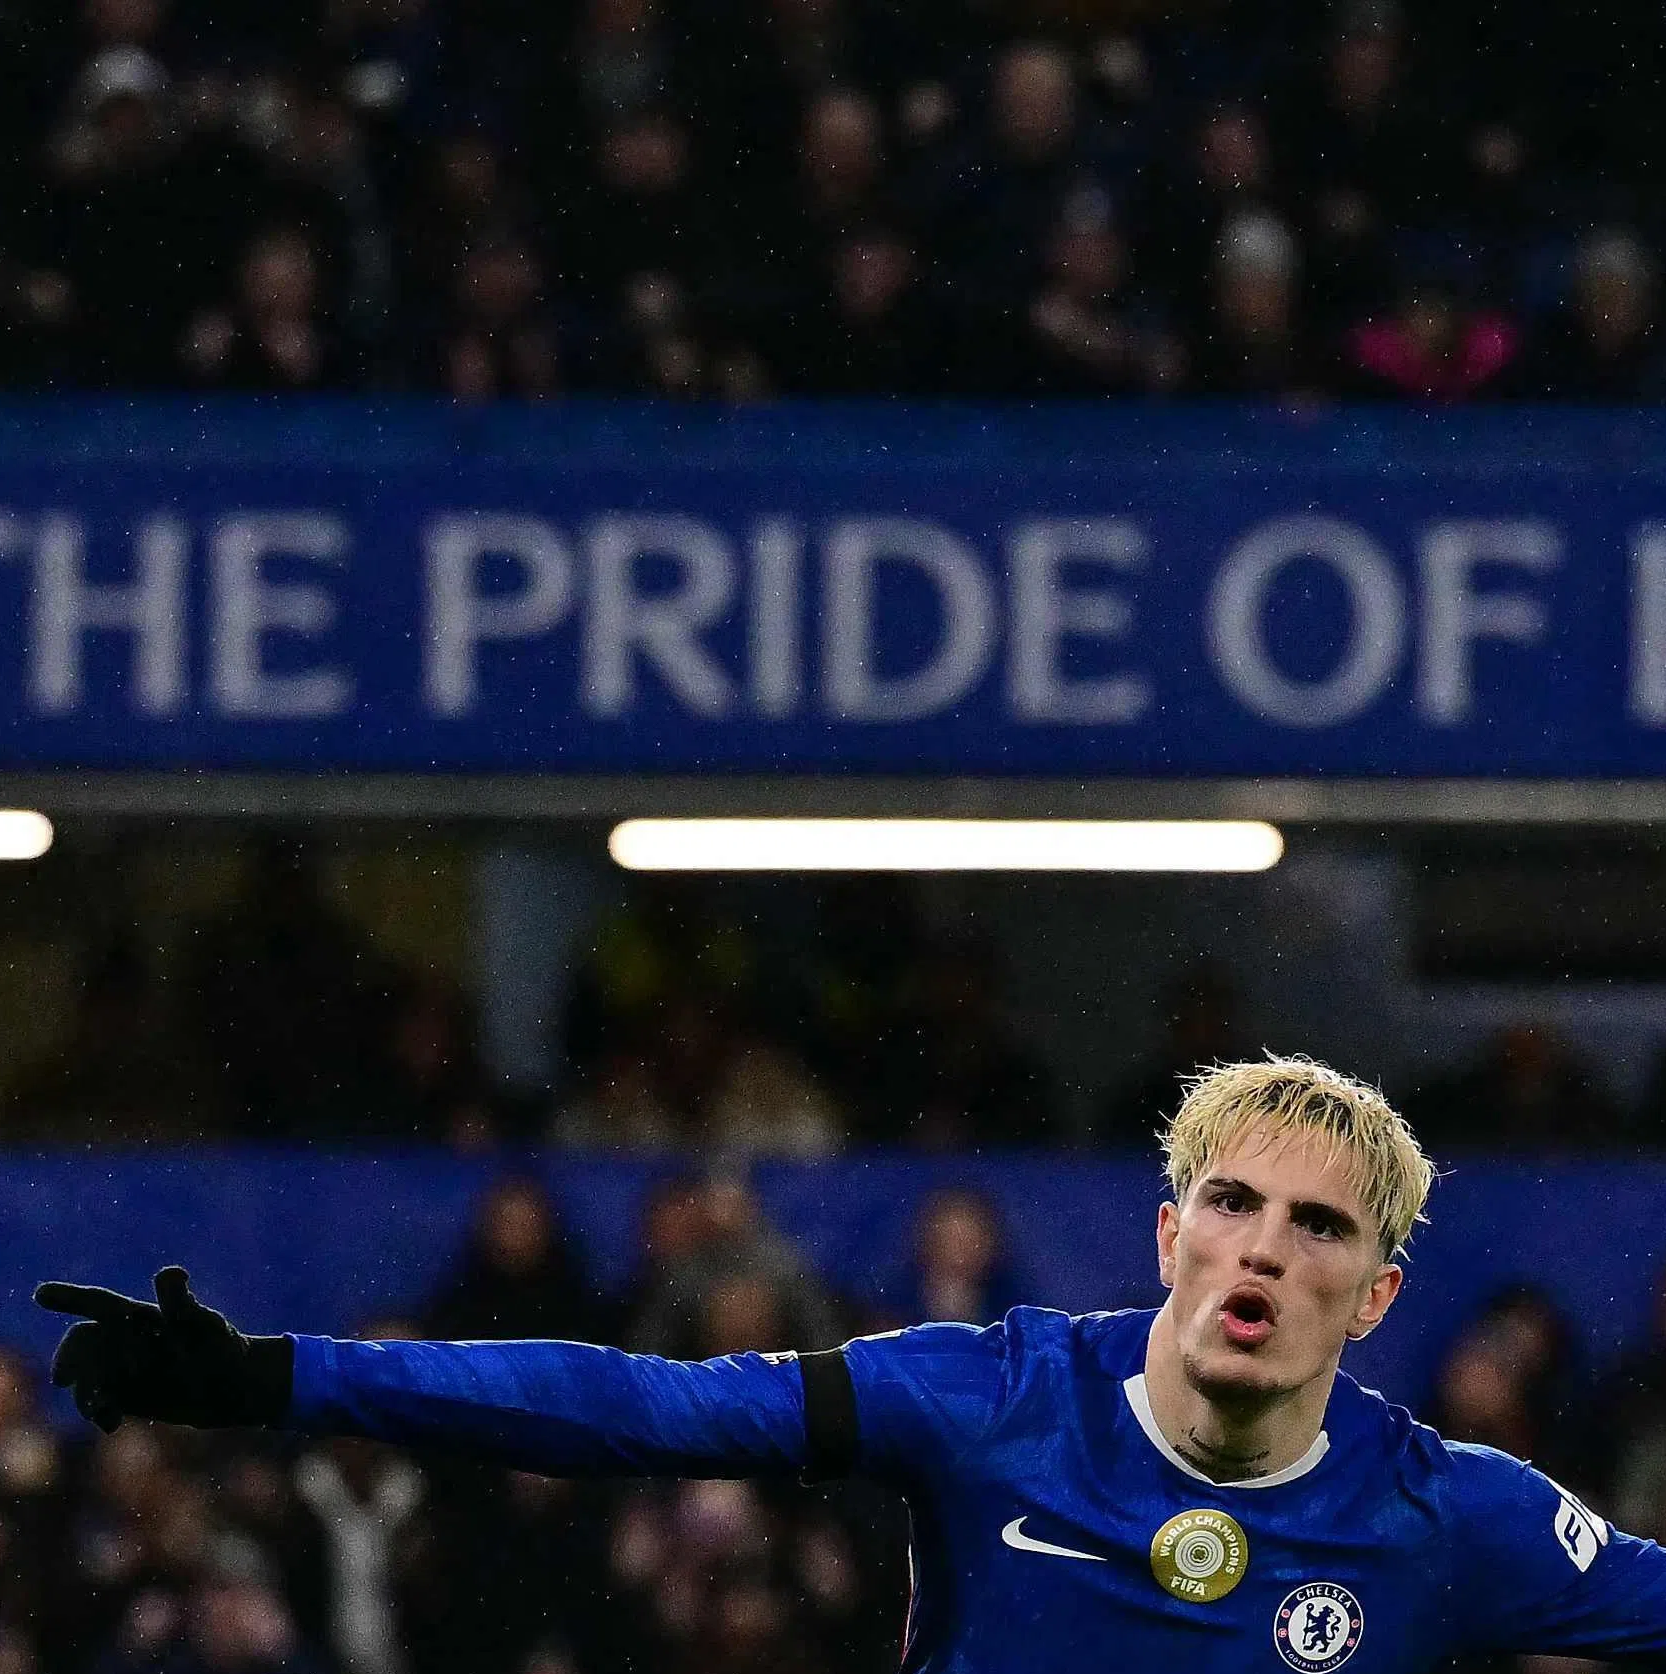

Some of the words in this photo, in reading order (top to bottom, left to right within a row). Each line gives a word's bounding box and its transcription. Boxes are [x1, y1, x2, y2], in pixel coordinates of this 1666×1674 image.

[423, 512, 1149, 721] PRIDE
[1205, 516, 1561, 726] OF
[1159, 1518, 1193, 1557] WORLD
[1195, 1515, 1240, 1575] CHAMPIONS
[1170, 1575, 1206, 1596] FIFA
[1295, 1586, 1352, 1609] CHELSEA
